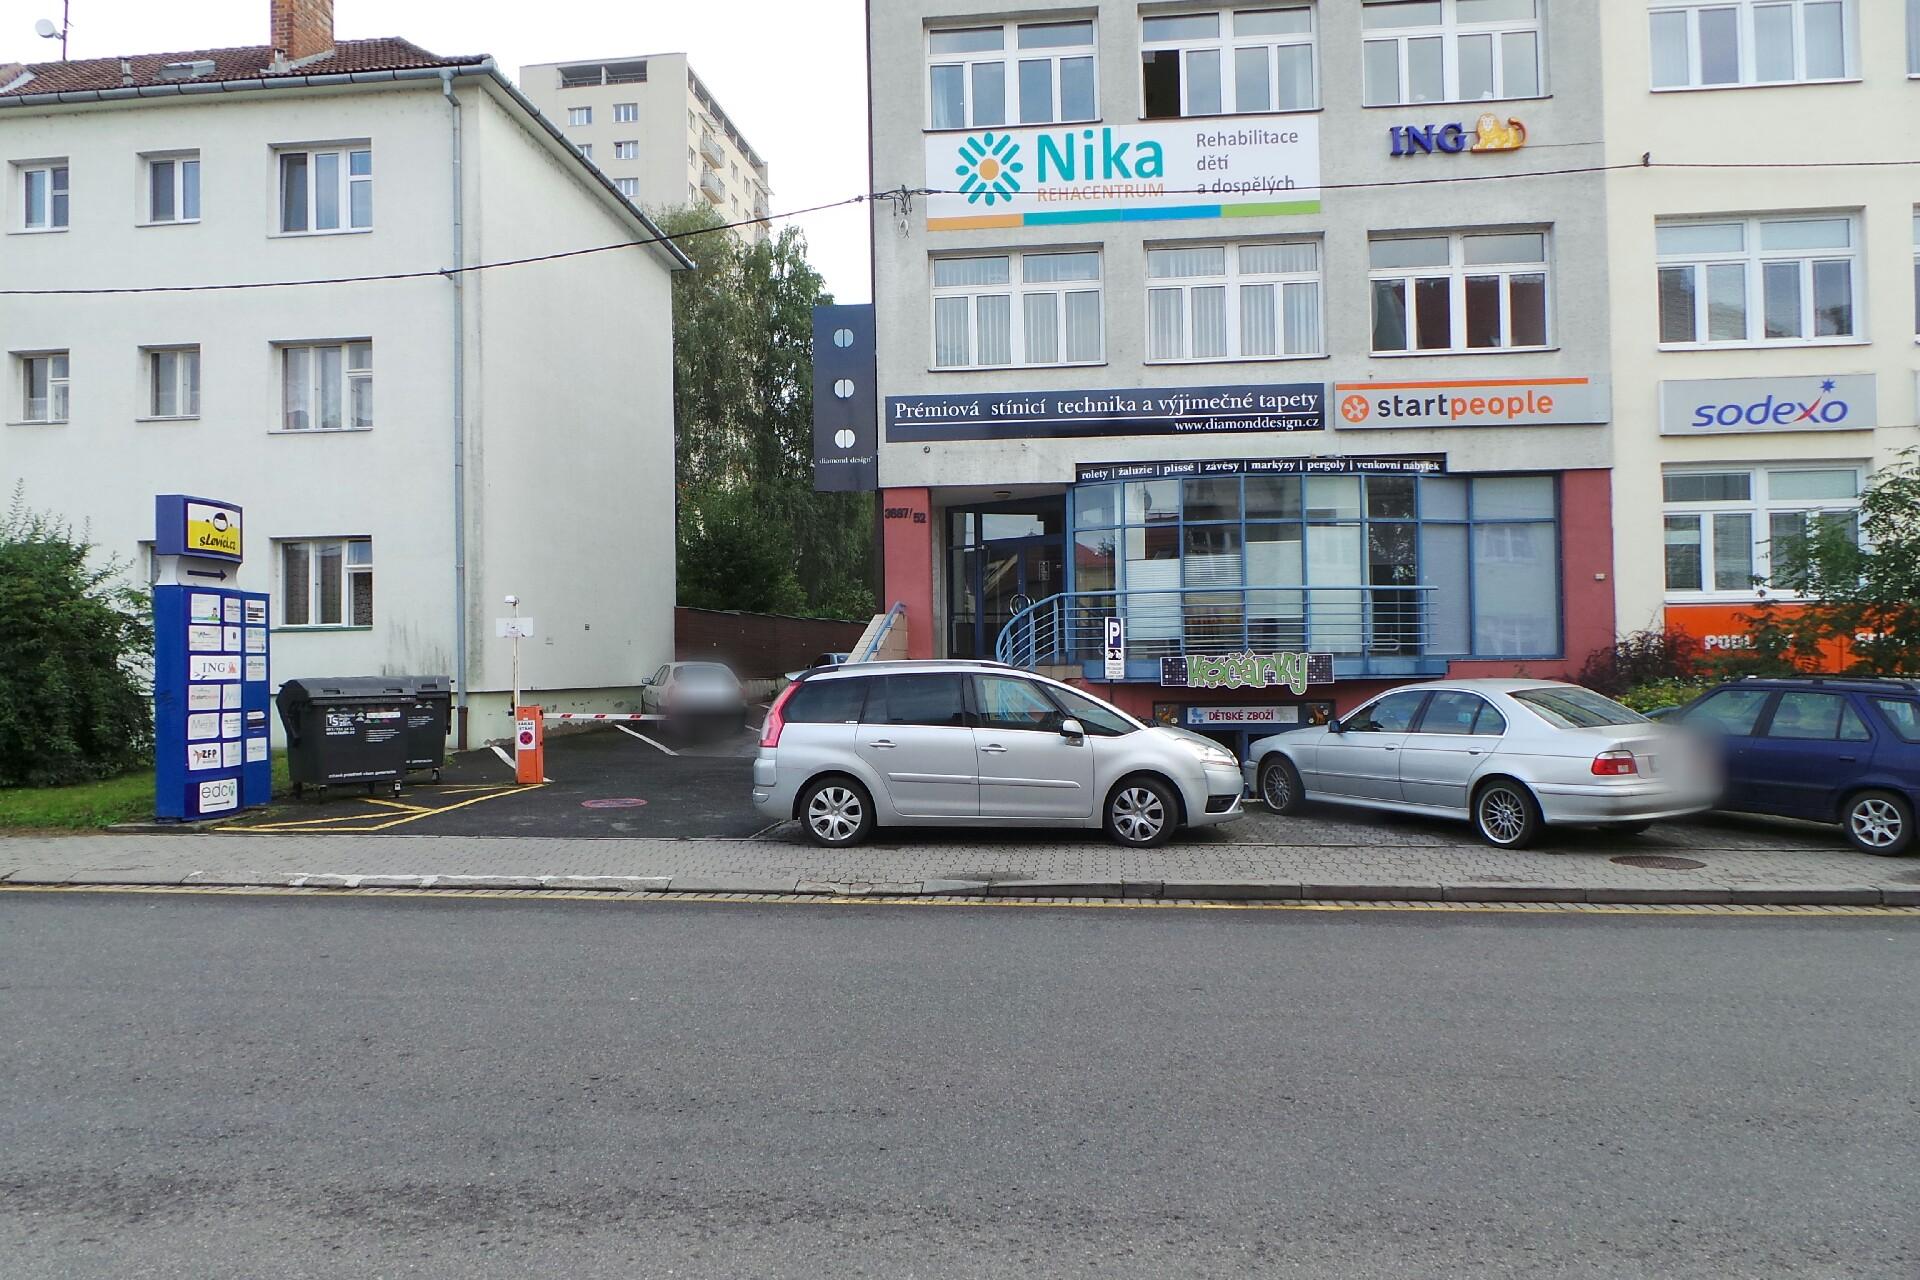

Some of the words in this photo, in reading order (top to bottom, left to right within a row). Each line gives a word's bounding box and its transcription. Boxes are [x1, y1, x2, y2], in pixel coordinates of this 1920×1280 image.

[1196, 129, 1298, 148] Rehabilitace
[1389, 122, 1467, 157] ING
[1037, 127, 1163, 183] Nika
[1196, 154, 1229, 171] dětí
[1037, 183, 1164, 203] REHACENTRUM
[1197, 183, 1206, 194] a
[1211, 175, 1295, 196] dospělých
[895, 401, 980, 419] Prémiová
[991, 398, 1046, 416] stínicí
[1057, 396, 1136, 414] technika
[1142, 400, 1153, 411] a
[1158, 393, 1253, 415] výjimečné
[1259, 394, 1318, 412] tapety
[1377, 390, 1553, 421] startpeople
[1692, 393, 1848, 427] sodexo
[1174, 417, 1320, 432] www.diamonddesign.cz
[1081, 469, 1109, 480] rolety
[1118, 466, 1153, 476] žaluzie
[1163, 463, 1194, 475] plissé
[1205, 462, 1240, 473] závěsy
[1251, 460, 1296, 471] markýzy
[1307, 461, 1346, 471] pergoly
[1356, 462, 1400, 470] venkovní
[1402, 462, 1440, 473] nábytek
[1109, 621, 1120, 645] P
[202, 662, 226, 673] ING
[1208, 710, 1244, 721] DĚTSKÉ
[1247, 710, 1274, 721] ZBOŽÍ
[202, 749, 217, 759] ZFP
